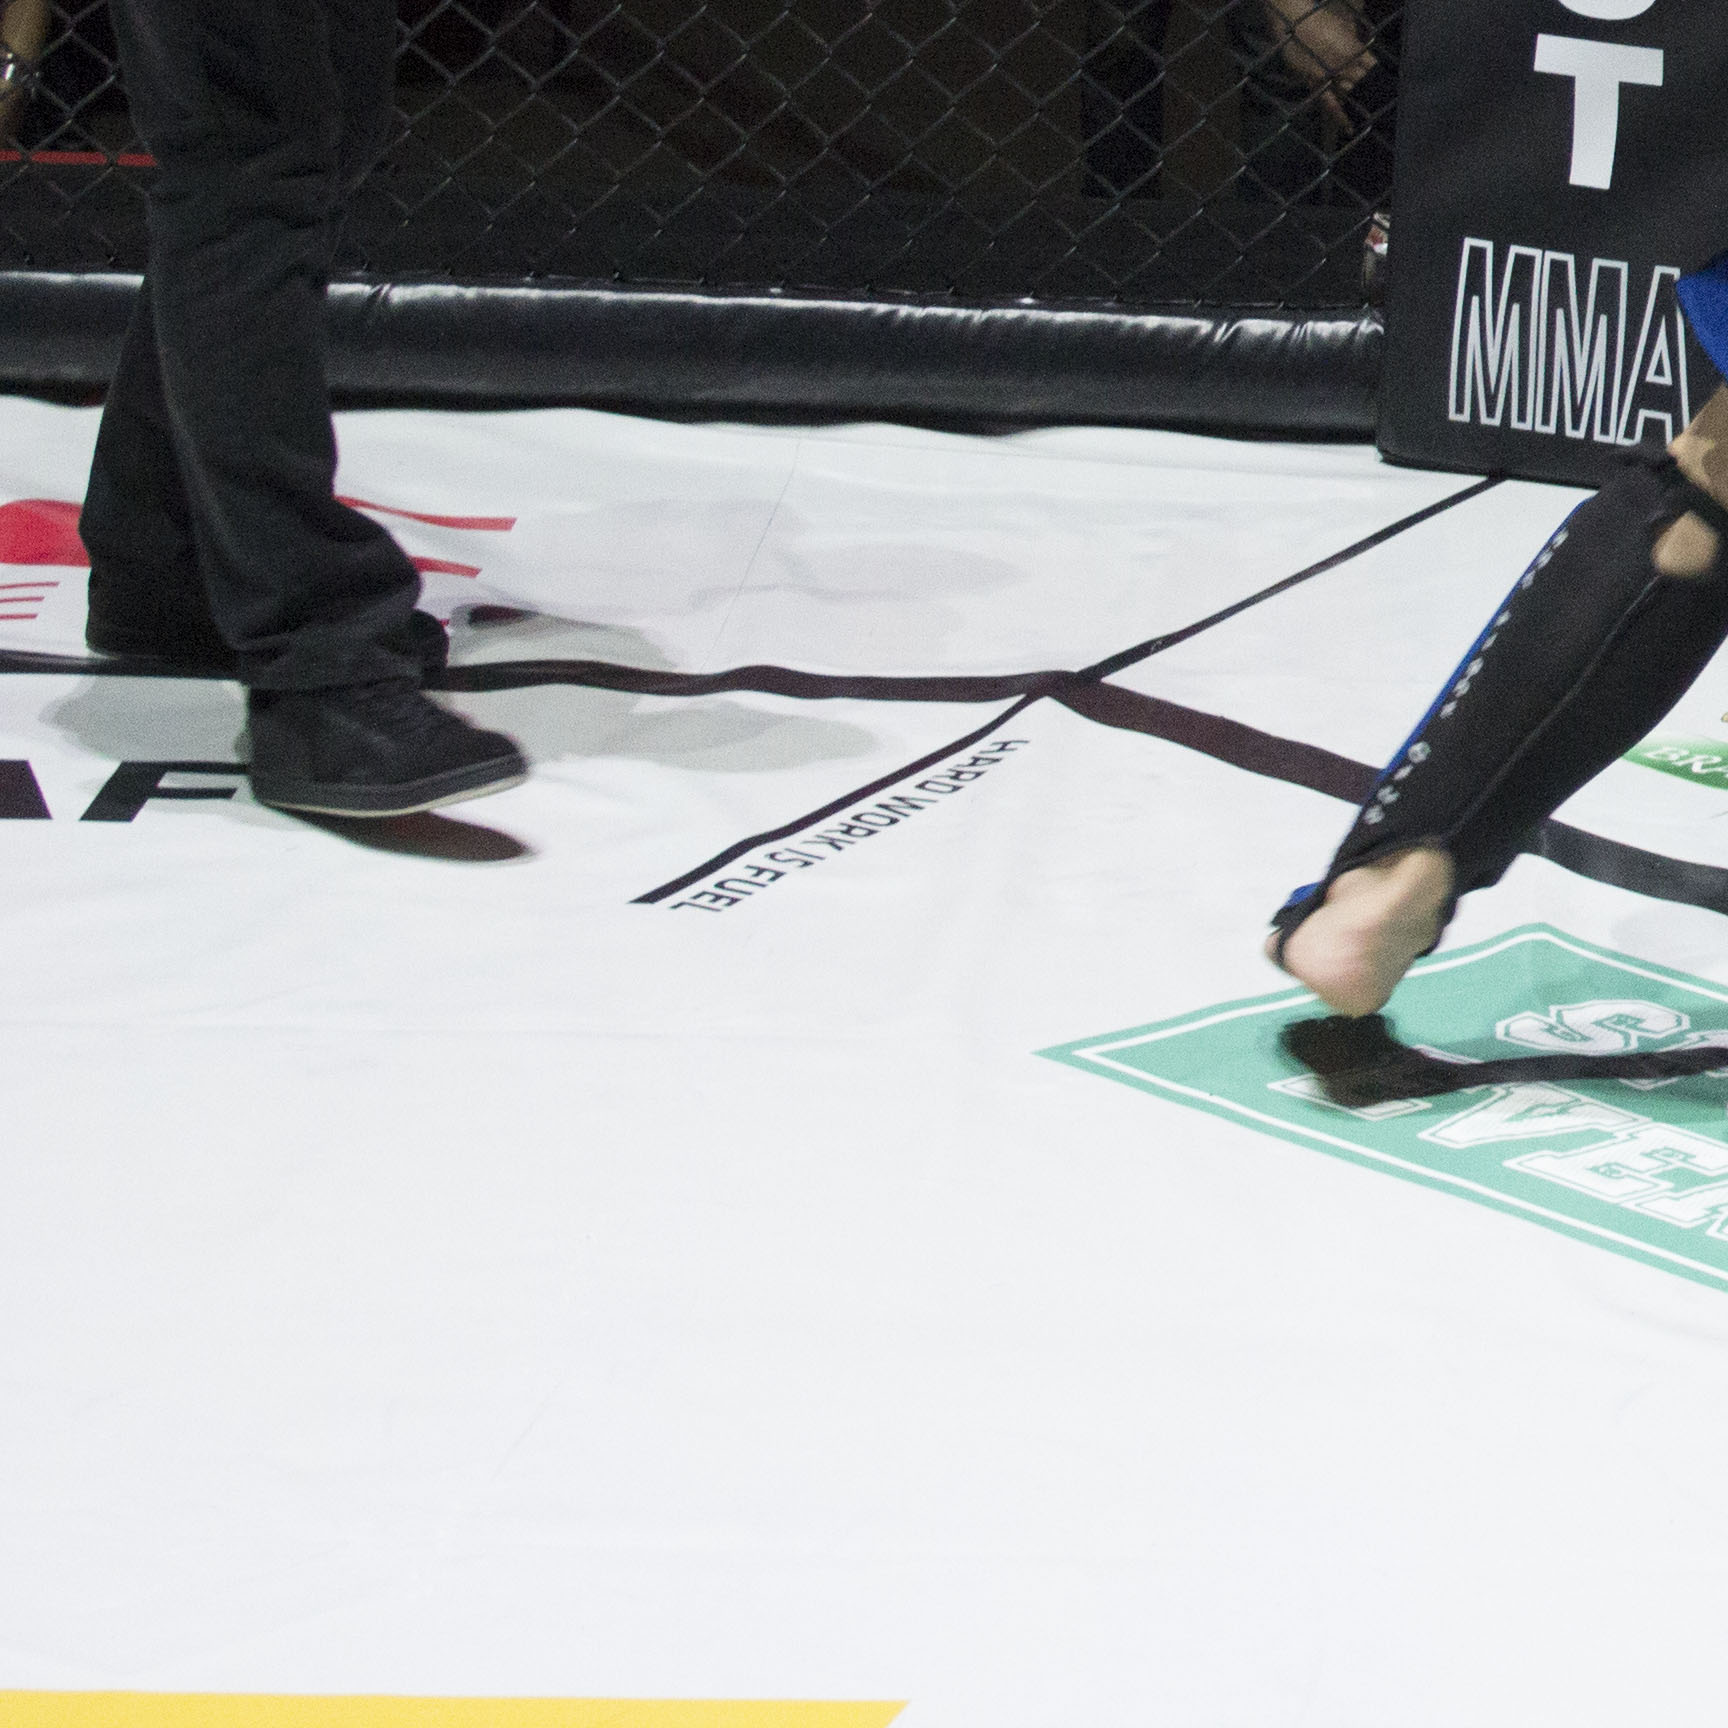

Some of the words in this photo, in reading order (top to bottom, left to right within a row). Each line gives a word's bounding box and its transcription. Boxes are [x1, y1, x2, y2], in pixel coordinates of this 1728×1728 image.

[1448, 237, 1690, 447] MMA
[914, 739, 1031, 795] HARD
[799, 795, 938, 852] WORK
[763, 847, 827, 869] IS
[667, 864, 787, 913] FUEL
